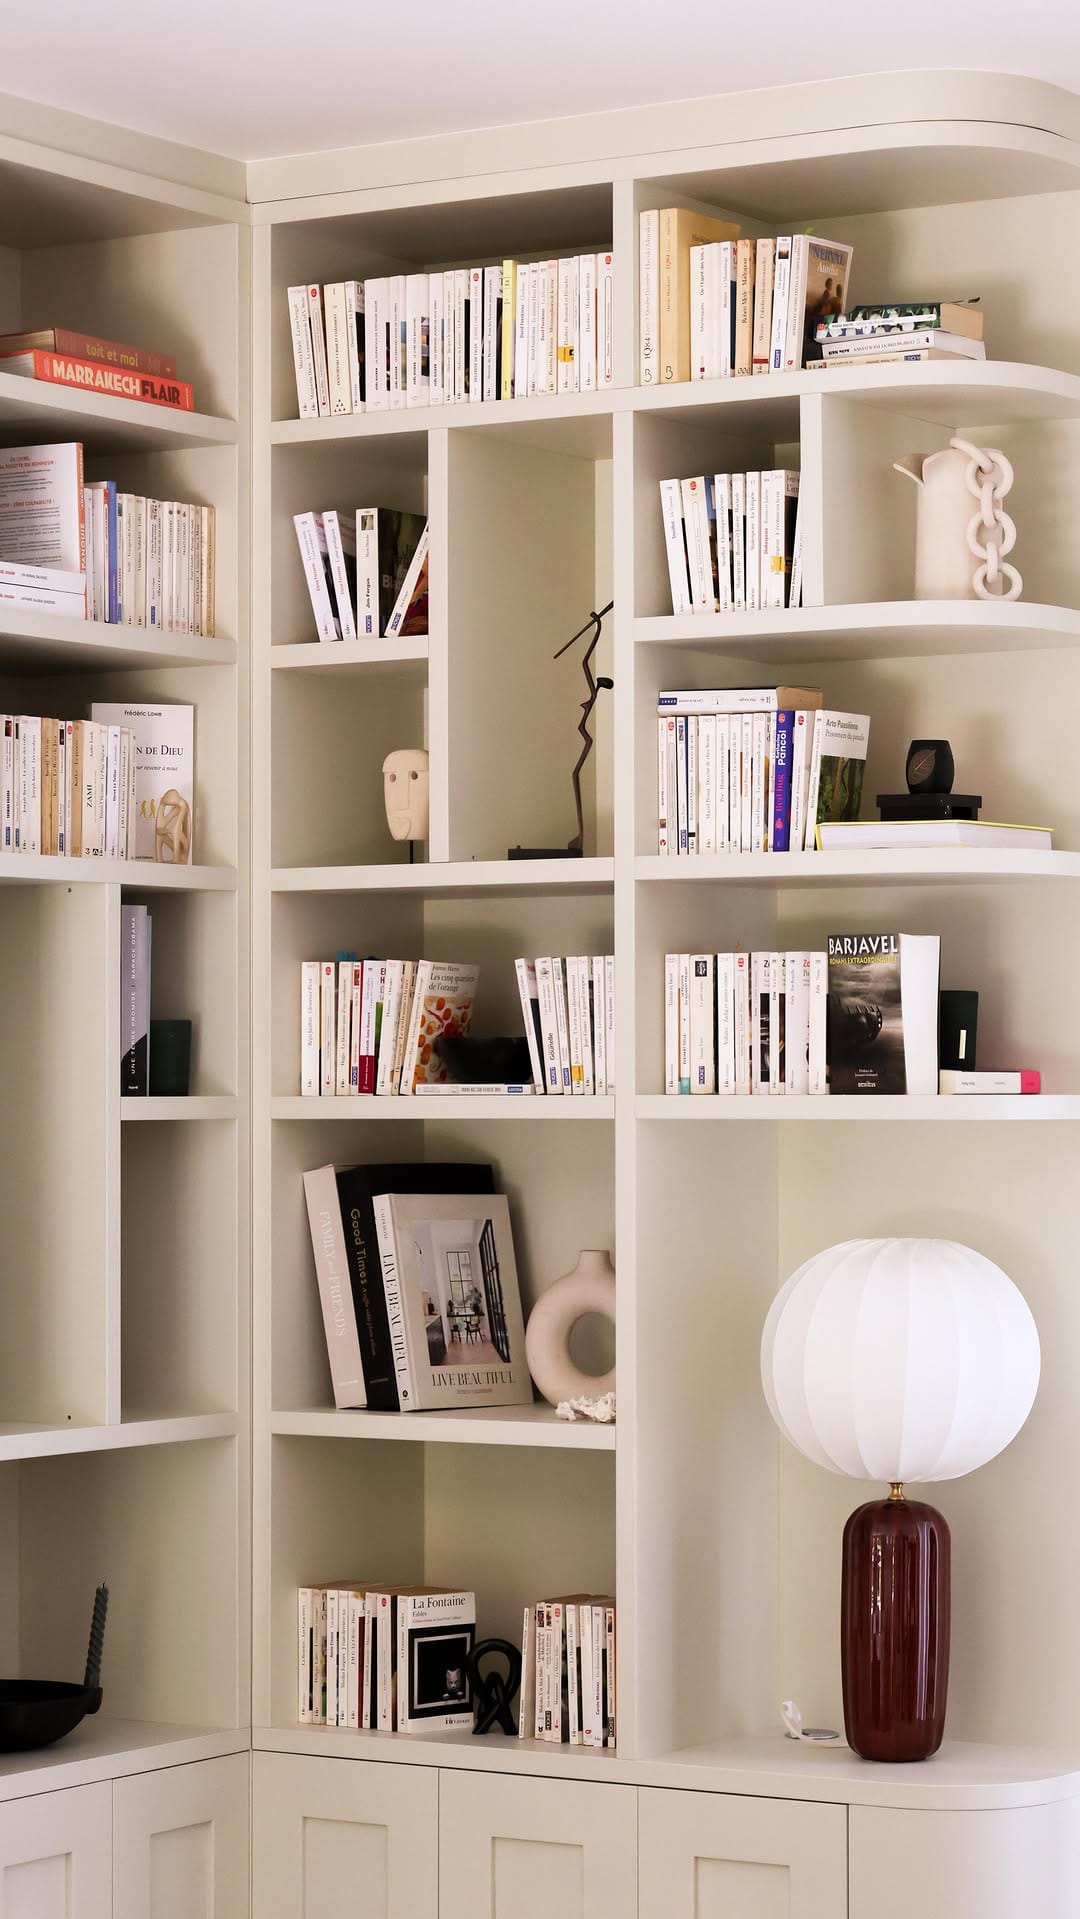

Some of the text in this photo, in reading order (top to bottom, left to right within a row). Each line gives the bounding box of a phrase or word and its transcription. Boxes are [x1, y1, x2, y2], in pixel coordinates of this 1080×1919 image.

[86, 344, 138, 367] toit et moi
[52, 360, 181, 405] MARRAKECH FLAIR
[146, 747, 158, 755] DE
[161, 744, 184, 756] DIEU
[778, 730, 786, 766] Pancol
[829, 936, 898, 955] BARJAVEL
[848, 956, 896, 964] EXTRAORDINAIRES
[351, 1208, 368, 1285] Good Times
[320, 1211, 336, 1258] FAMILY
[329, 1276, 347, 1336] FRIENDS
[383, 1252, 407, 1377] LIVE BEAUTIFUL
[432, 1371, 514, 1386] LIVE BEAUTIFUL
[413, 1596, 466, 1609] La Fontaine
